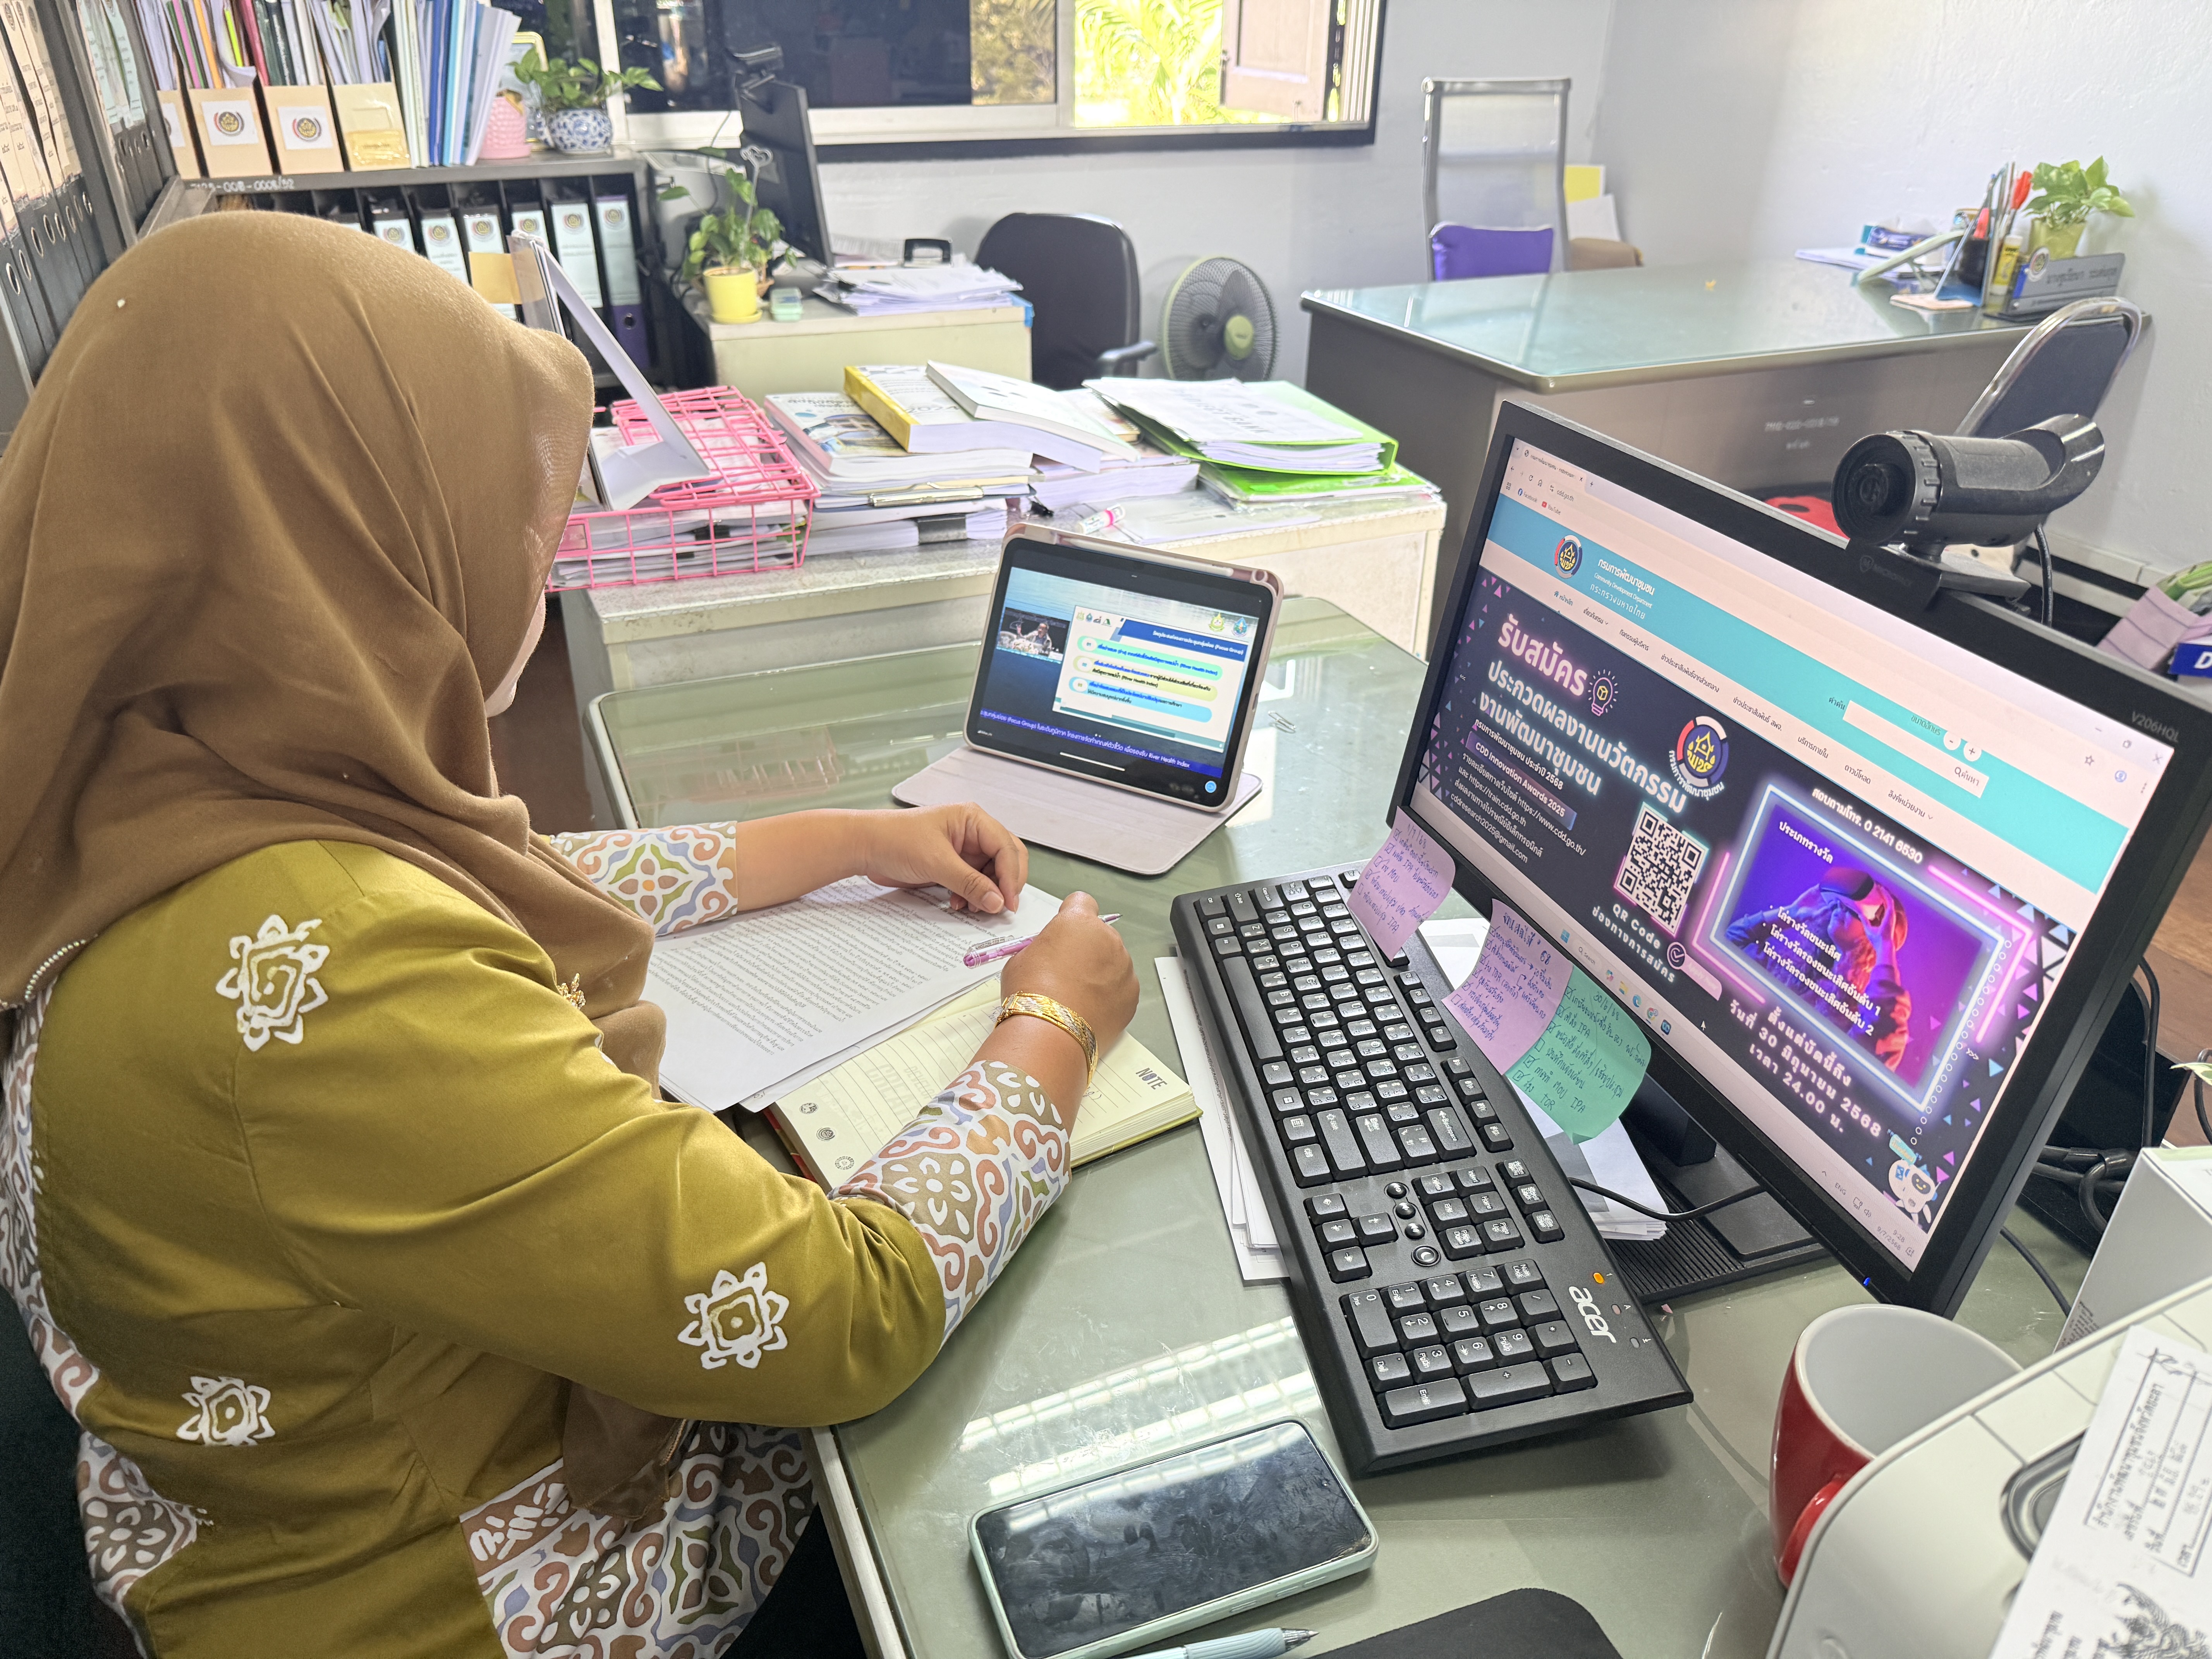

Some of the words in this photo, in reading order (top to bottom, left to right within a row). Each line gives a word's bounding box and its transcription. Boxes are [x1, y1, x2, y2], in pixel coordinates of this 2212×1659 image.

[1523, 491, 1537, 502] Facebook
[1556, 489, 1574, 503] cdd.go.th
[1547, 504, 1561, 515] YouTube
[1597, 558, 1655, 598] กรมการพัฒนาชุมชน
[1594, 572, 1612, 587] Community
[1611, 582, 1633, 599] Development
[1632, 594, 1652, 610] Department
[1590, 580, 1646, 620] กระทรวงมหาดไทย
[1498, 613, 1591, 697] รับสมัคร
[1487, 656, 1688, 815] ประกวดผลงานนวัตกรรม
[2131, 710, 2180, 744] V206HQL
[1477, 687, 1602, 801] งานพัฒนาชุมชน
[1797, 733, 1830, 759] บริการภายใน
[1474, 718, 1525, 763] กรมการพัฒนาชุมชน
[1525, 755, 1546, 777] ประจำปี
[1546, 771, 1563, 790] 2568
[1475, 741, 1489, 757] CDD
[1489, 752, 1522, 784] Innovation
[1522, 779, 1548, 804] Awards
[1547, 799, 1565, 817] 2025
[1669, 750, 1725, 801] กรมการพัฒนาชุมชน
[1458, 766, 1468, 779] และ
[1468, 774, 1526, 828] https://train.cdd.go.th
[1450, 792, 1528, 864] cddresearch2025@gmail.com
[1517, 797, 1585, 857] https://www.cdd.go.th/
[1811, 786, 1865, 828] สอบถามโทร.
[1863, 820, 1872, 832] 0
[1872, 825, 1895, 847] 2141
[1894, 840, 1923, 864] 6530
[1778, 818, 1835, 865] ประเภทรางวัล
[1402, 859, 1414, 872] IPA
[1387, 867, 1400, 883] MOU
[1261, 887, 1269, 895] Caps
[1385, 917, 1400, 934] IPA
[1612, 903, 1628, 923] QR
[1630, 917, 1661, 950] Code
[1592, 904, 1676, 984] ช่องทางการสมัคร
[1539, 950, 1552, 965] 68
[1583, 951, 1596, 966] Search
[1491, 967, 1503, 982] TOR
[1592, 991, 1622, 1020] 30/6/68
[1576, 1022, 1592, 1039] IPA
[1865, 1024, 1874, 1036] 2
[1728, 998, 1756, 1029] วันที่
[1758, 1027, 1778, 1049] 30
[1780, 1046, 1838, 1103] มิถุนายน
[1840, 1096, 1883, 1138] 2568
[1135, 1067, 1168, 1090] NOTE
[1748, 1041, 1780, 1075] เวลา
[1783, 1071, 1826, 1115] 24.00
[1829, 1111, 1847, 1133] น.
[1540, 1093, 1556, 1110] TOR
[1551, 1081, 1568, 1099] MOU
[1570, 1097, 1587, 1115] IPA
[1329, 1120, 1339, 1130] Shift
[1441, 1118, 1459, 1142] Backspace
[1467, 1170, 1479, 1183] Insert
[1835, 1183, 1846, 1195] ENG
[1480, 1195, 1494, 1210] Home
[1877, 1226, 1901, 1251] 9/7/2568
[1893, 1230, 1905, 1243] 9:28
[1511, 1265, 1525, 1279] Lock
[1519, 1264, 1532, 1277] Num
[1468, 1274, 1482, 1290] Home
[1352, 1296, 1362, 1307] Ins
[1391, 1288, 1401, 1302] End
[1566, 1283, 1618, 1347] acer
[1498, 1336, 1512, 1352] PgUp
[1376, 1360, 1388, 1373] Del
[1417, 1352, 1431, 1369] PgDn
[1418, 1389, 1431, 1406] Enter
